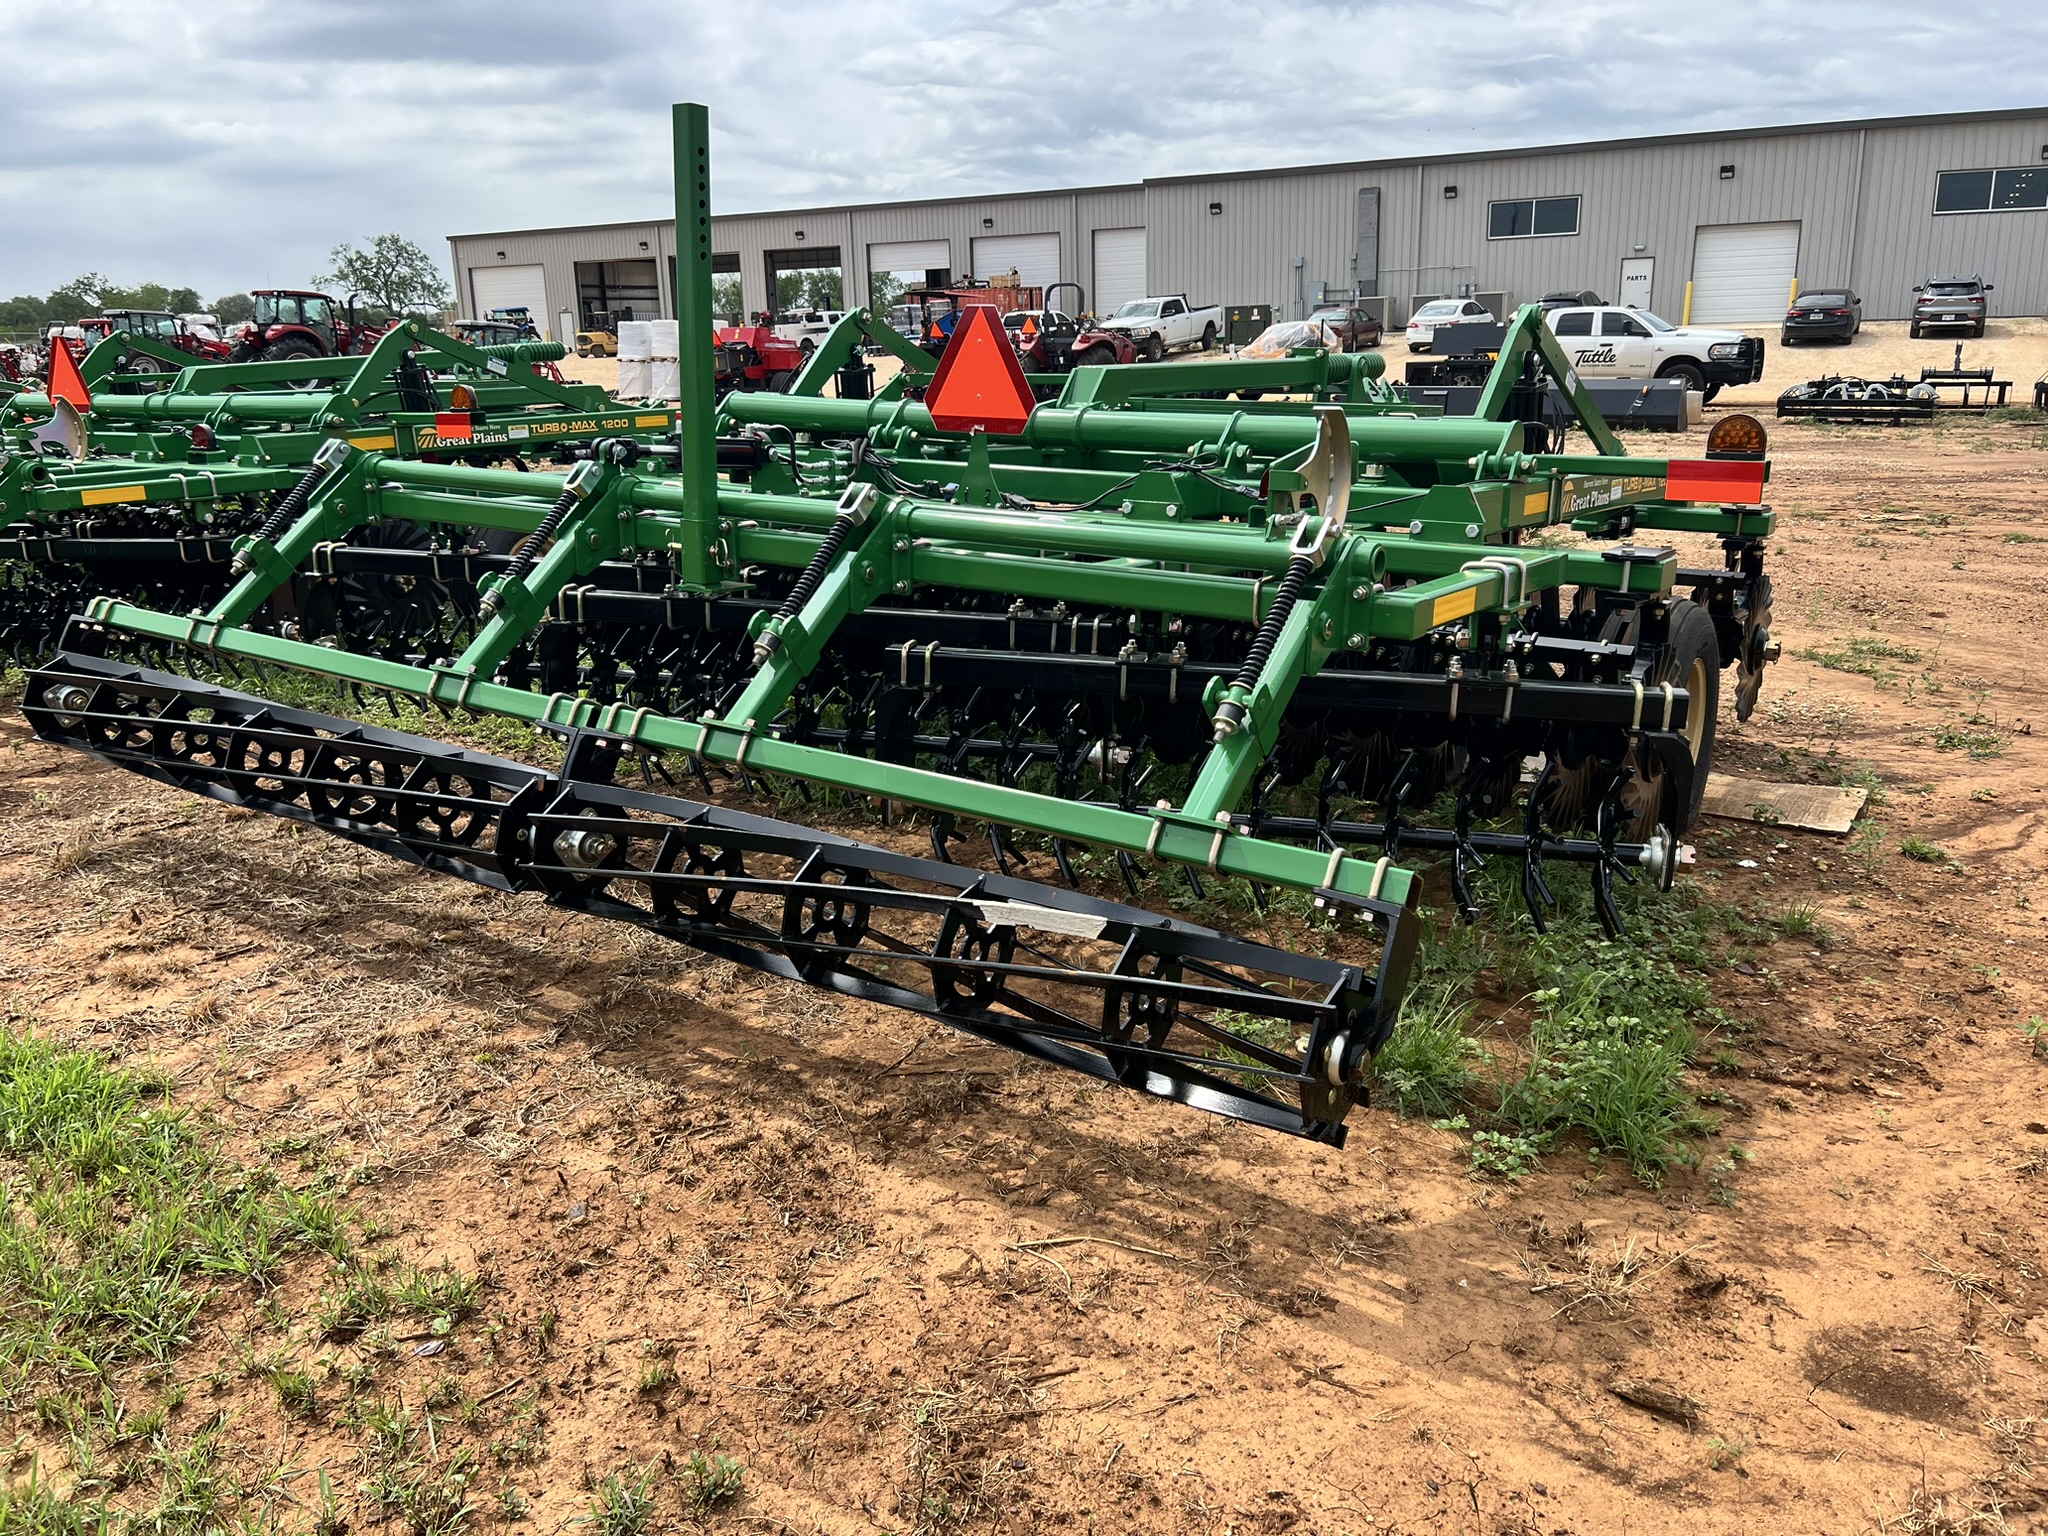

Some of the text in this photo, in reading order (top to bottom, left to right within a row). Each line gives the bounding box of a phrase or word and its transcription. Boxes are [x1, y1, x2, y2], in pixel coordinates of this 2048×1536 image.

[1575, 348, 1616, 367] Tuttle
[601, 418, 629, 429] 1200
[472, 432, 508, 444] Plains
[1571, 495, 1590, 511] Great
[1591, 490, 1609, 506] Plains
